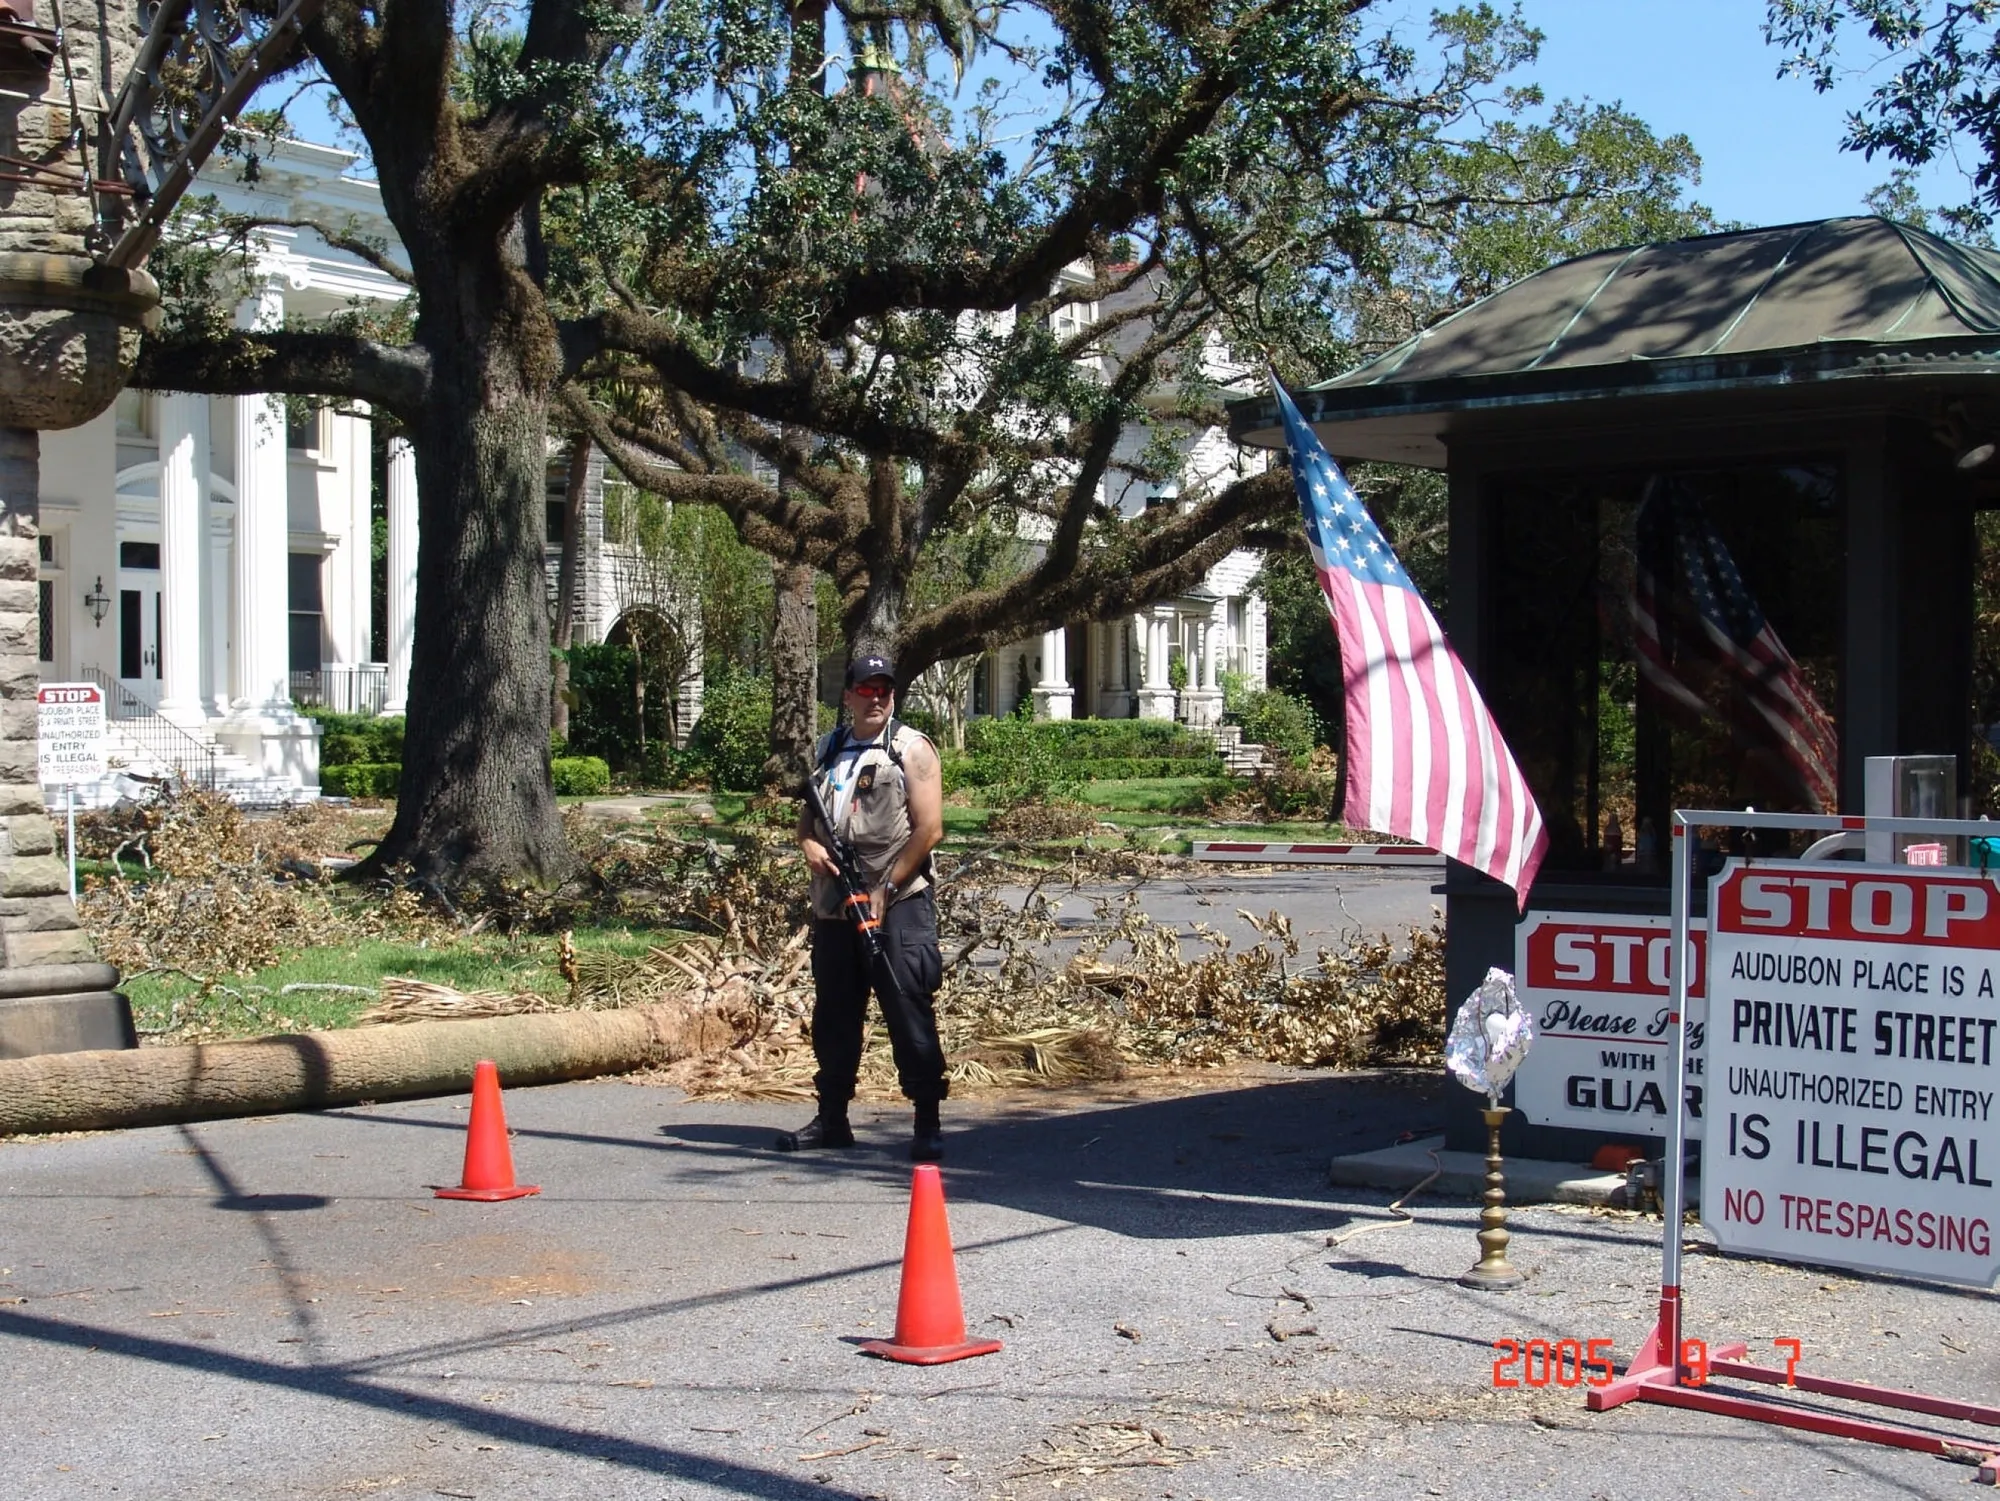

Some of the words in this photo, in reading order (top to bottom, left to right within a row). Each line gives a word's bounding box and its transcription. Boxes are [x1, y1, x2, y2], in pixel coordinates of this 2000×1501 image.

[44, 690, 91, 702] STOP
[76, 705, 100, 715] PLACE
[38, 730, 101, 740] UNAUTHORIZED
[53, 716, 75, 726] PRIVATE
[78, 716, 100, 726] STREET
[40, 753, 51, 764] IS
[56, 752, 99, 764] ILLEGAL
[52, 742, 87, 752] ENTRY
[53, 764, 101, 775] TRESPASSING
[1740, 875, 1989, 938] STOP
[1553, 932, 1698, 988] STO
[1731, 951, 1841, 987] AUDUBON
[1853, 959, 1929, 994] PLACE
[1942, 966, 1965, 997] IS
[1977, 968, 1994, 999] A
[1540, 1000, 1637, 1035] Please
[1733, 999, 1857, 1054] PRIVATE
[1874, 1010, 1998, 1066] STREET
[1601, 1051, 1656, 1072] WITH
[1566, 1075, 1703, 1118] GUAR
[1728, 1066, 1903, 1111] UNAUTHORIZED
[1915, 1084, 1994, 1121] ENTRY
[1729, 1112, 1771, 1160] IS
[1797, 1119, 1993, 1188] ILLEGAL
[1724, 1187, 1765, 1226] NO
[1779, 1193, 1991, 1257] TRESPASSING
